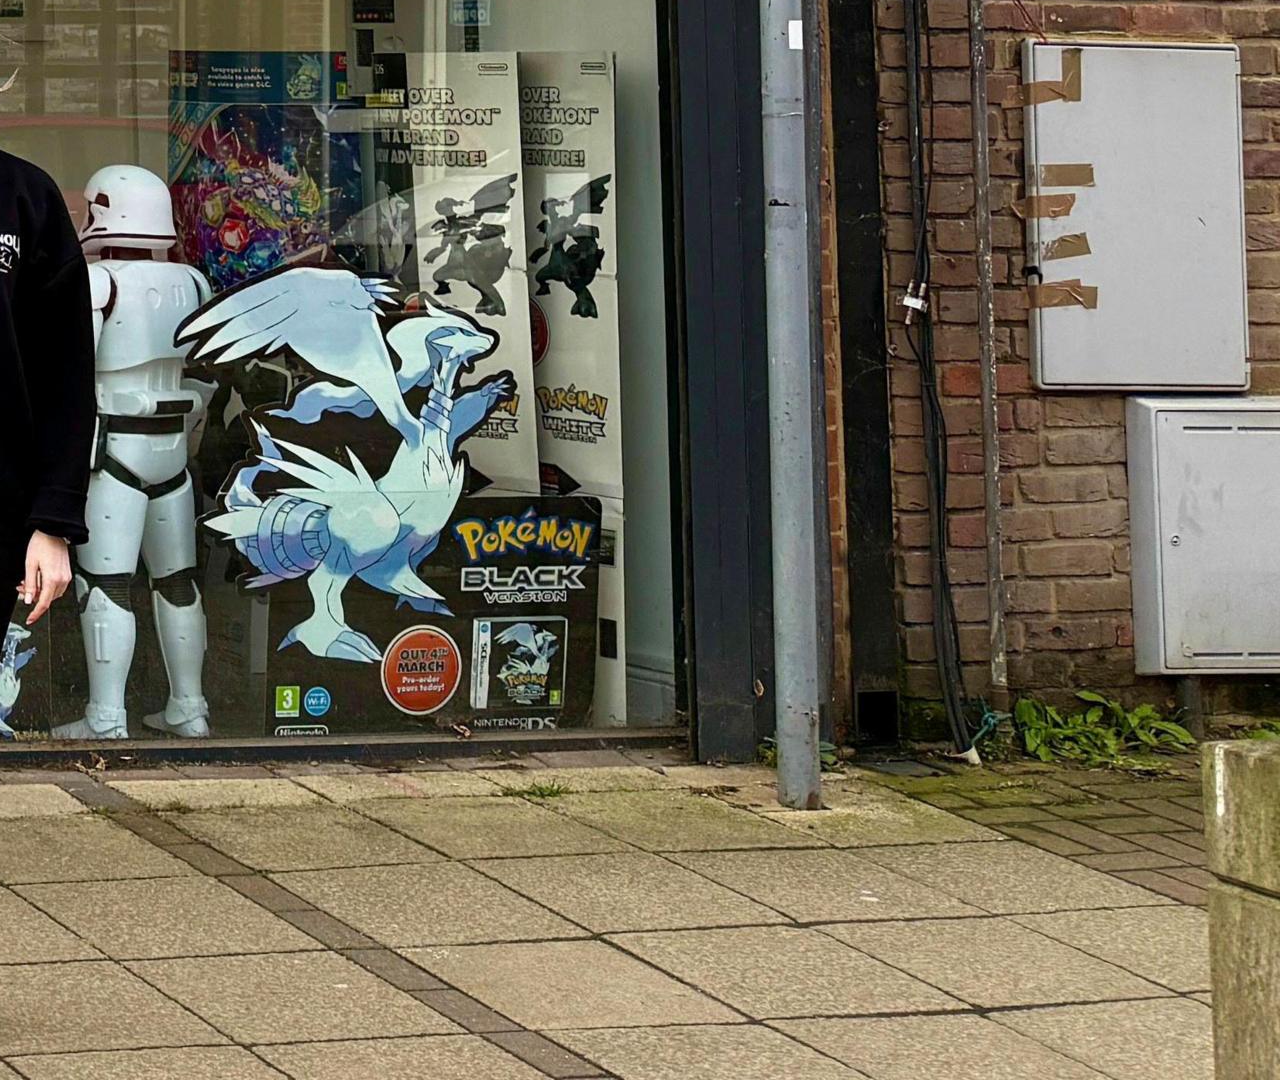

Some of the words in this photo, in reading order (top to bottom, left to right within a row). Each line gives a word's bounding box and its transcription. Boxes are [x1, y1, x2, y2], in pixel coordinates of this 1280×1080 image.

[408, 87, 454, 105] OVER
[403, 129, 460, 146] BRAND
[523, 128, 564, 146] RAND
[391, 150, 487, 168] ADVENTURE!
[523, 149, 586, 168] ENTURE!
[542, 415, 607, 438] WHITE
[460, 565, 587, 592] BLACK
[483, 591, 568, 605] VERSION
[399, 647, 429, 662] OUT
[397, 660, 446, 673] MARCH
[396, 684, 422, 693] yours
[423, 683, 445, 693] today!
[281, 689, 293, 706] 3
